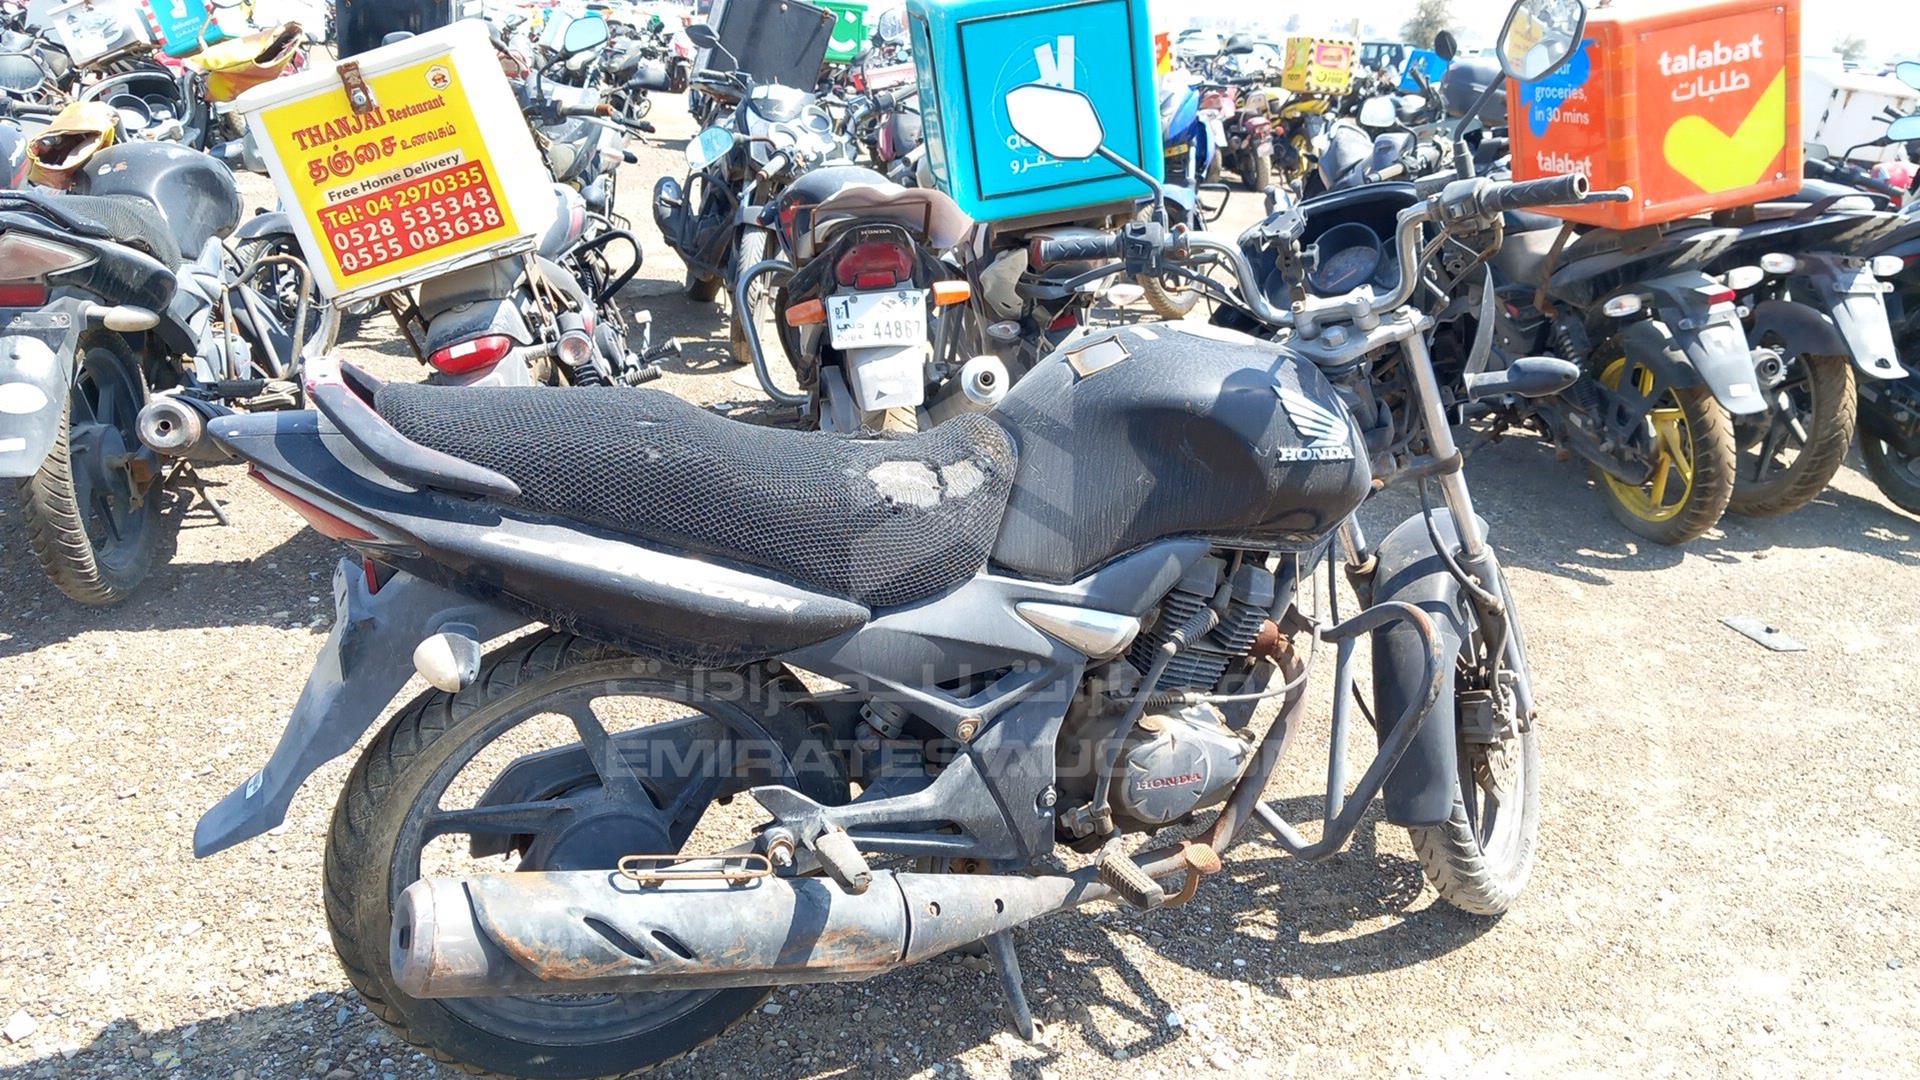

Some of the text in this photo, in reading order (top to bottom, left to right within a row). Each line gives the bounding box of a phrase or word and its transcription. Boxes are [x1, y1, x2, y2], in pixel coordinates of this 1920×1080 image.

[1657, 33, 1763, 76] talabat
[1535, 85, 1588, 102] groceries,
[1671, 69, 1750, 102] طلبات
[292, 94, 446, 151] THANJAI Restaurant
[1534, 106, 1590, 125] in 30 mins
[328, 153, 460, 202] Free Home Delivery
[1536, 150, 1592, 178] talabat
[324, 166, 483, 229] Tel: 04 2970335
[333, 187, 491, 250] 0528 535343
[342, 207, 499, 271] 0555 083638
[841, 299, 850, 319] 1
[874, 320, 920, 340] 44867
[1278, 447, 1355, 461] HONDA
[1136, 773, 1203, 792] HONDA
